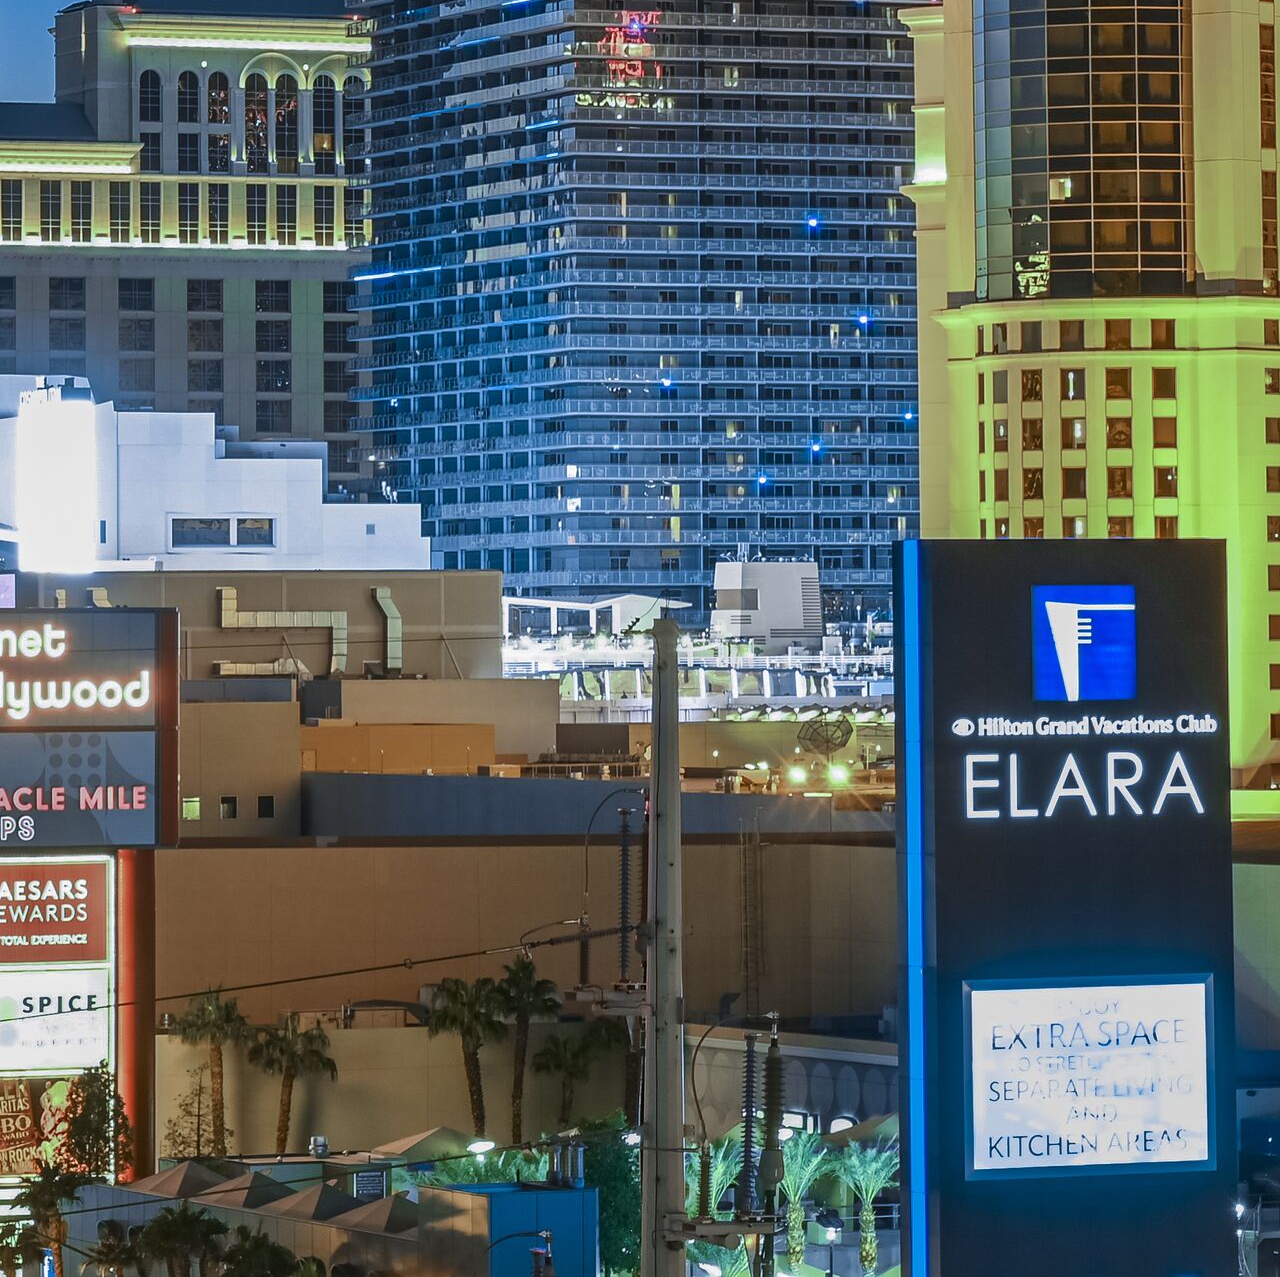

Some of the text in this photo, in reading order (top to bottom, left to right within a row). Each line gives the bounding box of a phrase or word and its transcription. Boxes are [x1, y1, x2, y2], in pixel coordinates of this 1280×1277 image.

[978, 713, 1218, 737] Hilton Grand Vacations Club
[966, 750, 1205, 819] ELARA
[79, 785, 147, 811] MILE
[0, 935, 29, 946] TOTAL
[30, 933, 88, 945] EXPERIENCE
[22, 994, 97, 1014] SPICE
[991, 1019, 1187, 1050] EXTRA SPACE
[988, 1078, 1106, 1103] SEPARATE
[1066, 1103, 1118, 1123] AND
[2, 1130, 30, 1141] WABO
[988, 1127, 1188, 1159] KITCHEN AREAS
